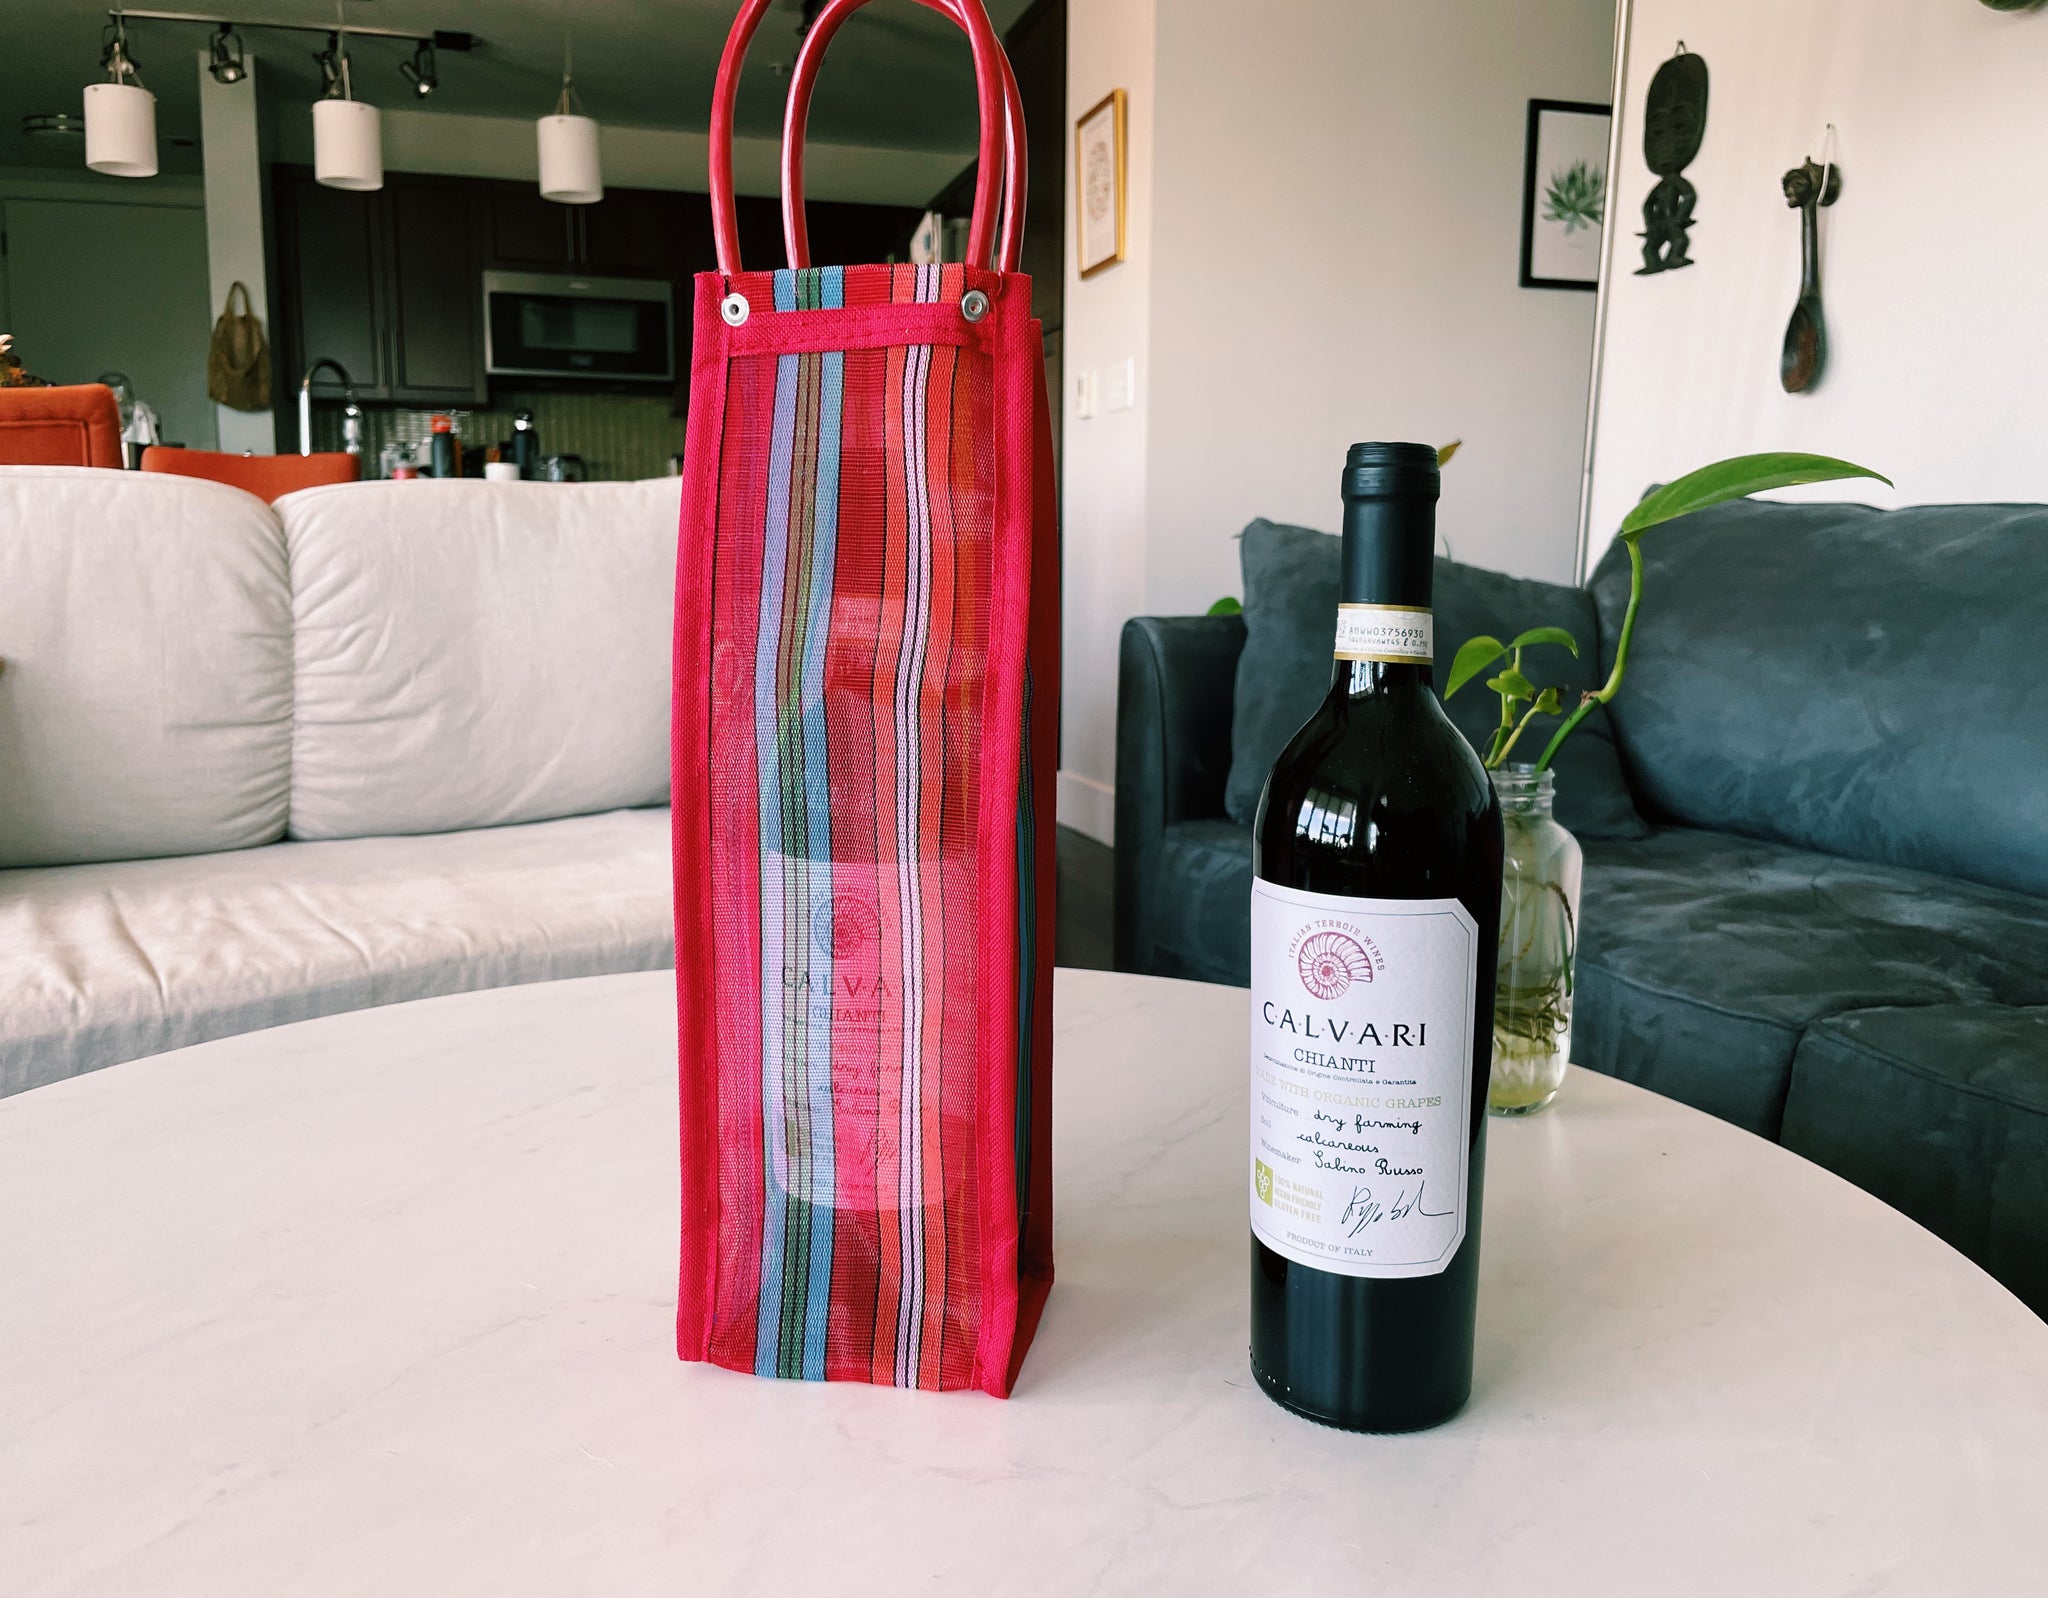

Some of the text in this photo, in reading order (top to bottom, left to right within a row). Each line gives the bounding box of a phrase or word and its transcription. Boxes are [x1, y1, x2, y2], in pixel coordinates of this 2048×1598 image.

[1288, 919, 1385, 971] ITALIAN TERROIR WINES
[1294, 1048, 1377, 1073] CHIANTI
[1306, 1069, 1332, 1080] Origine
[1333, 1074, 1374, 1085] Controllata
[1278, 1076, 1310, 1098] WITH
[1313, 1089, 1381, 1109] ORGANIC
[1385, 1095, 1442, 1109] GRAPES
[1313, 1109, 1347, 1132] dry
[1354, 1113, 1423, 1135] farming
[1296, 1131, 1380, 1154] calcareous
[1312, 1150, 1367, 1175] Sabino
[1374, 1157, 1425, 1176] Russo
[1292, 1182, 1325, 1200] NATURAL
[1273, 1198, 1322, 1224] GLUTEN FREE
[1285, 1230, 1375, 1257] PRODUCT OF ITALY
